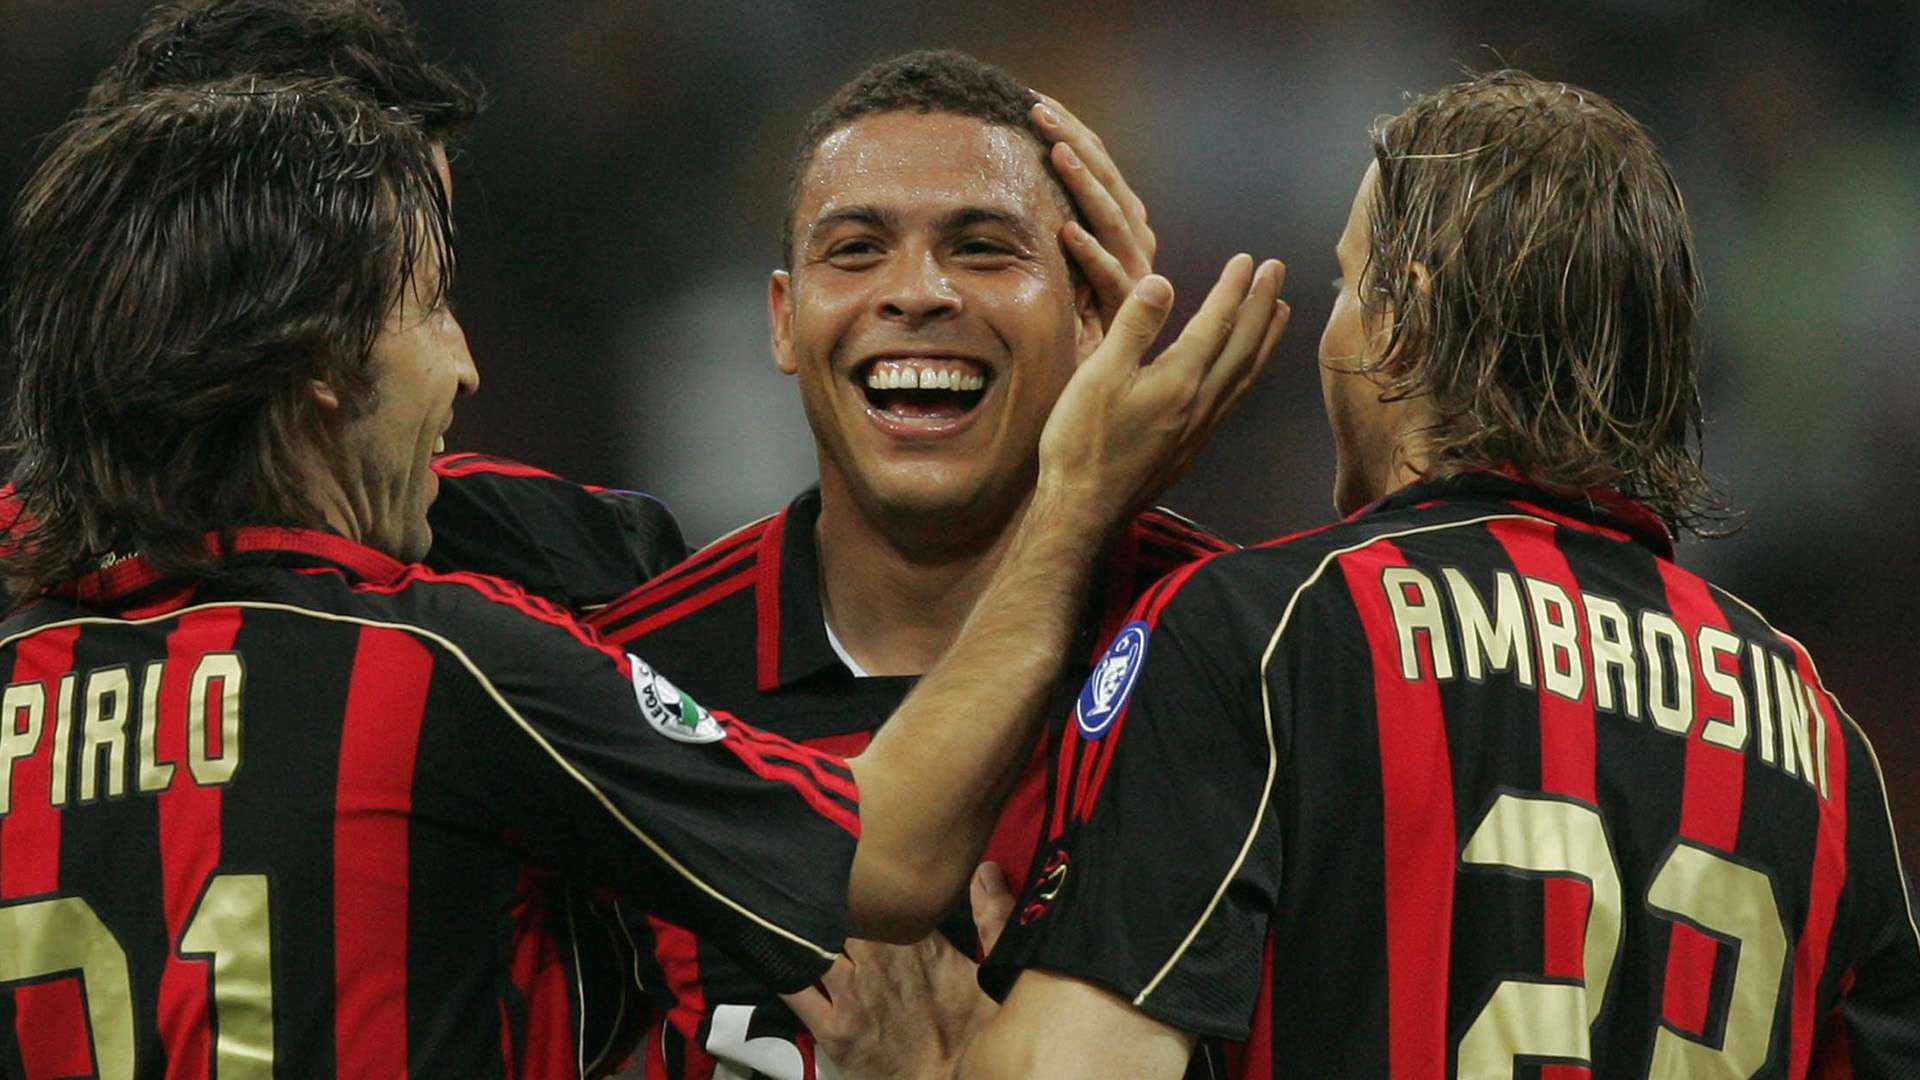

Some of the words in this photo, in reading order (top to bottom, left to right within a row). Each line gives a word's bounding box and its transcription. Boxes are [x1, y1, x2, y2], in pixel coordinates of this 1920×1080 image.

[0, 652, 243, 813] PIRLO
[642, 684, 670, 726] LEGA
[1381, 567, 1829, 801] AMBROSINI
